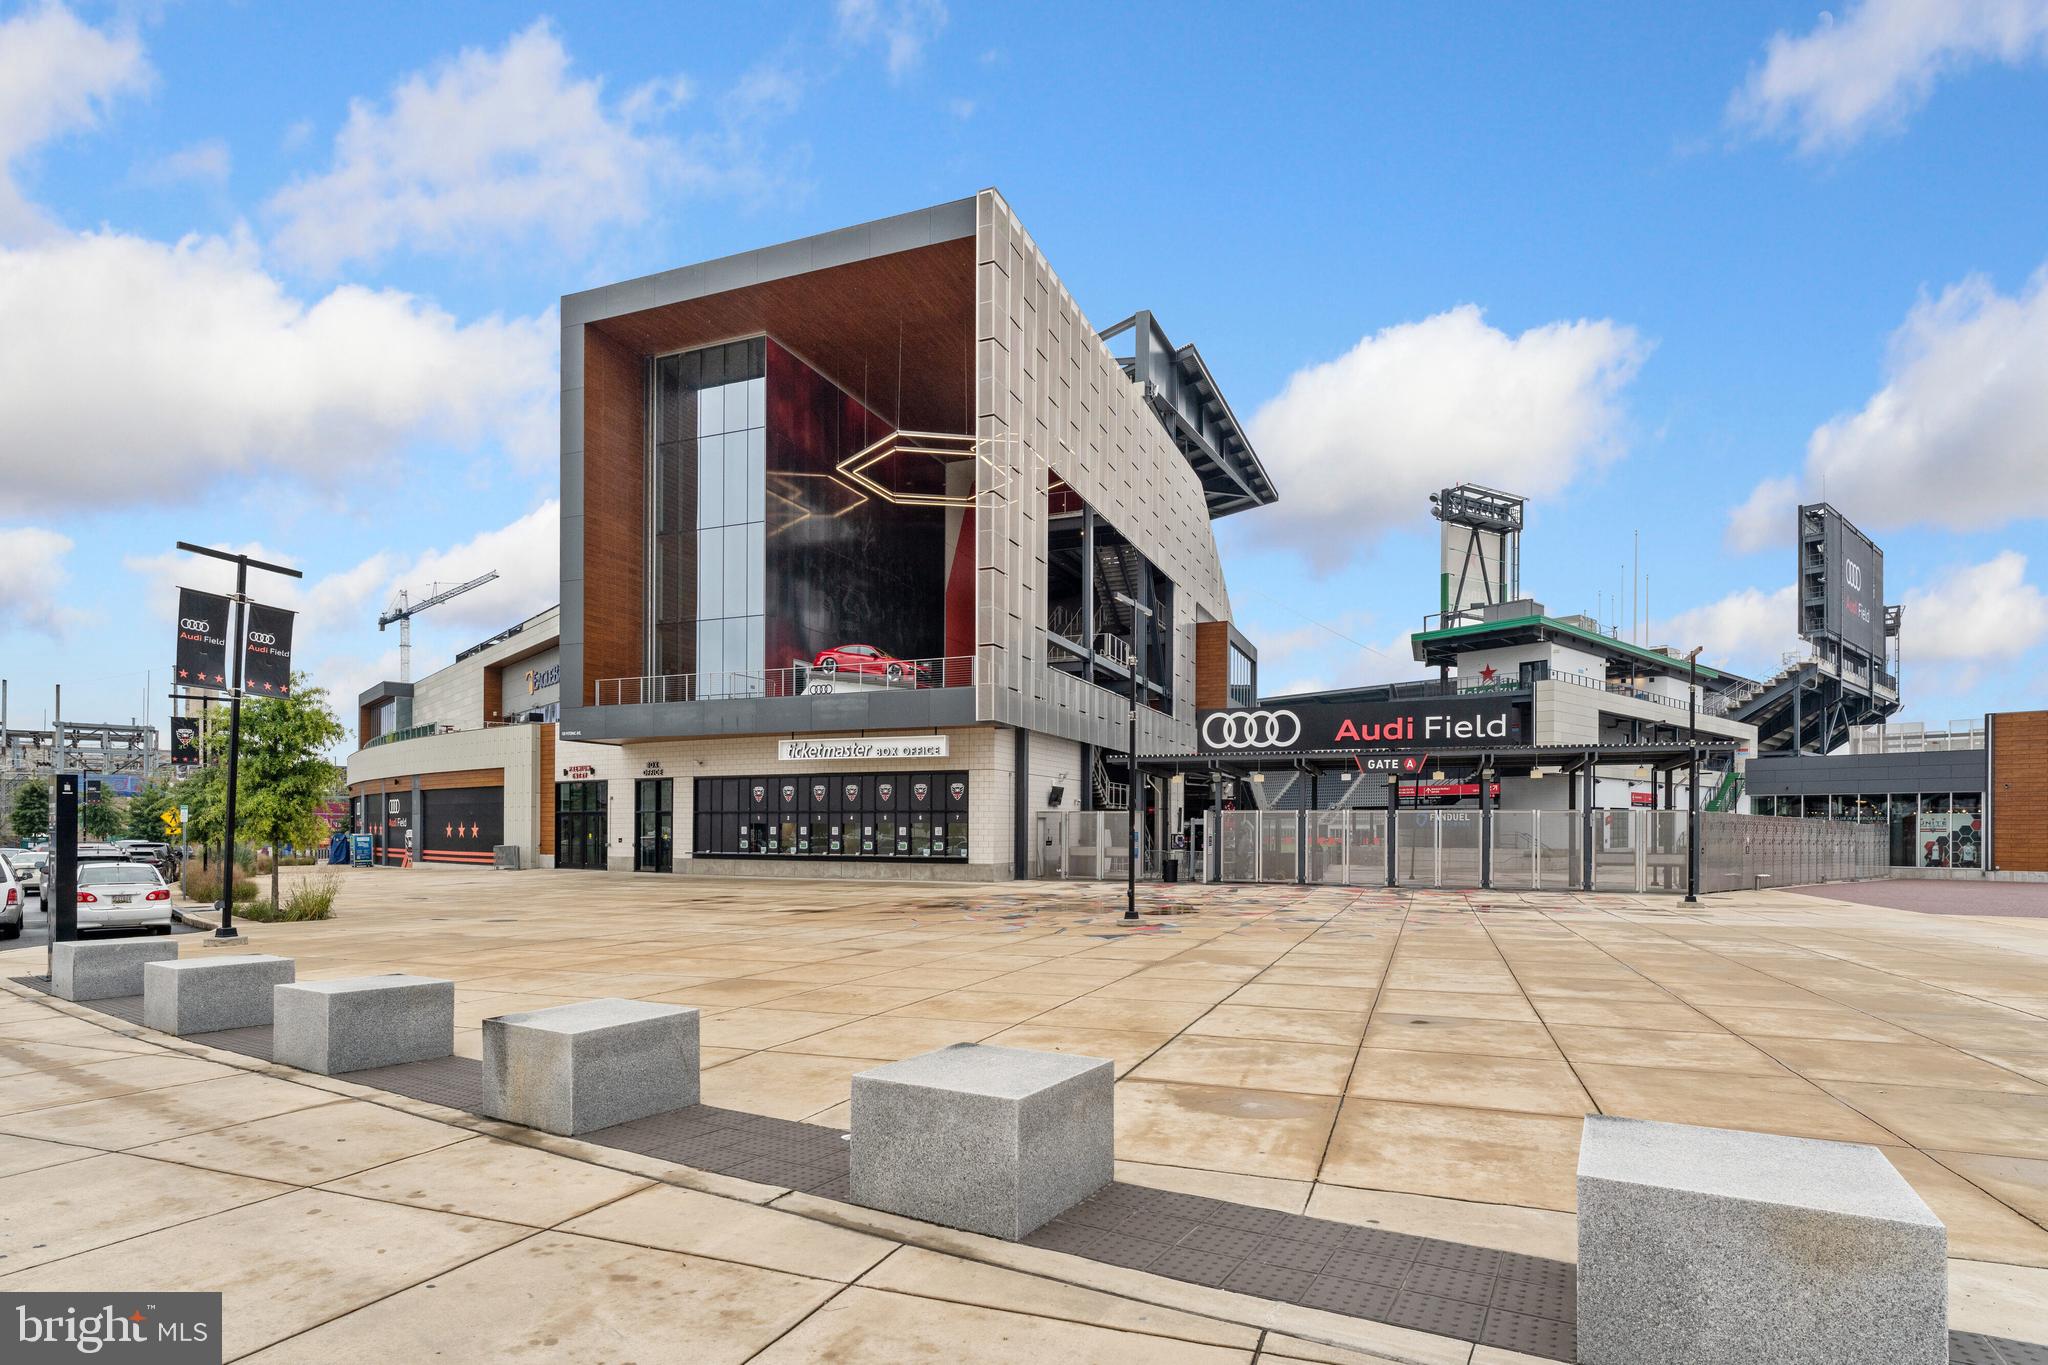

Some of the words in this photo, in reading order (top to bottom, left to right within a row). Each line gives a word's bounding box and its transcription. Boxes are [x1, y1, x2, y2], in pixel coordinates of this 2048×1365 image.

[180, 632, 202, 642] Audi
[203, 636, 225, 646] Field
[248, 644, 268, 654] Audi
[269, 647, 290, 657] Field
[1334, 716, 1415, 742] Audi
[1425, 713, 1507, 740] Field
[787, 742, 873, 759] ticketmaster
[876, 746, 898, 757] BOX
[902, 745, 941, 756] OFFICE
[1367, 759, 1399, 769] GATE
[1405, 759, 1414, 768] A
